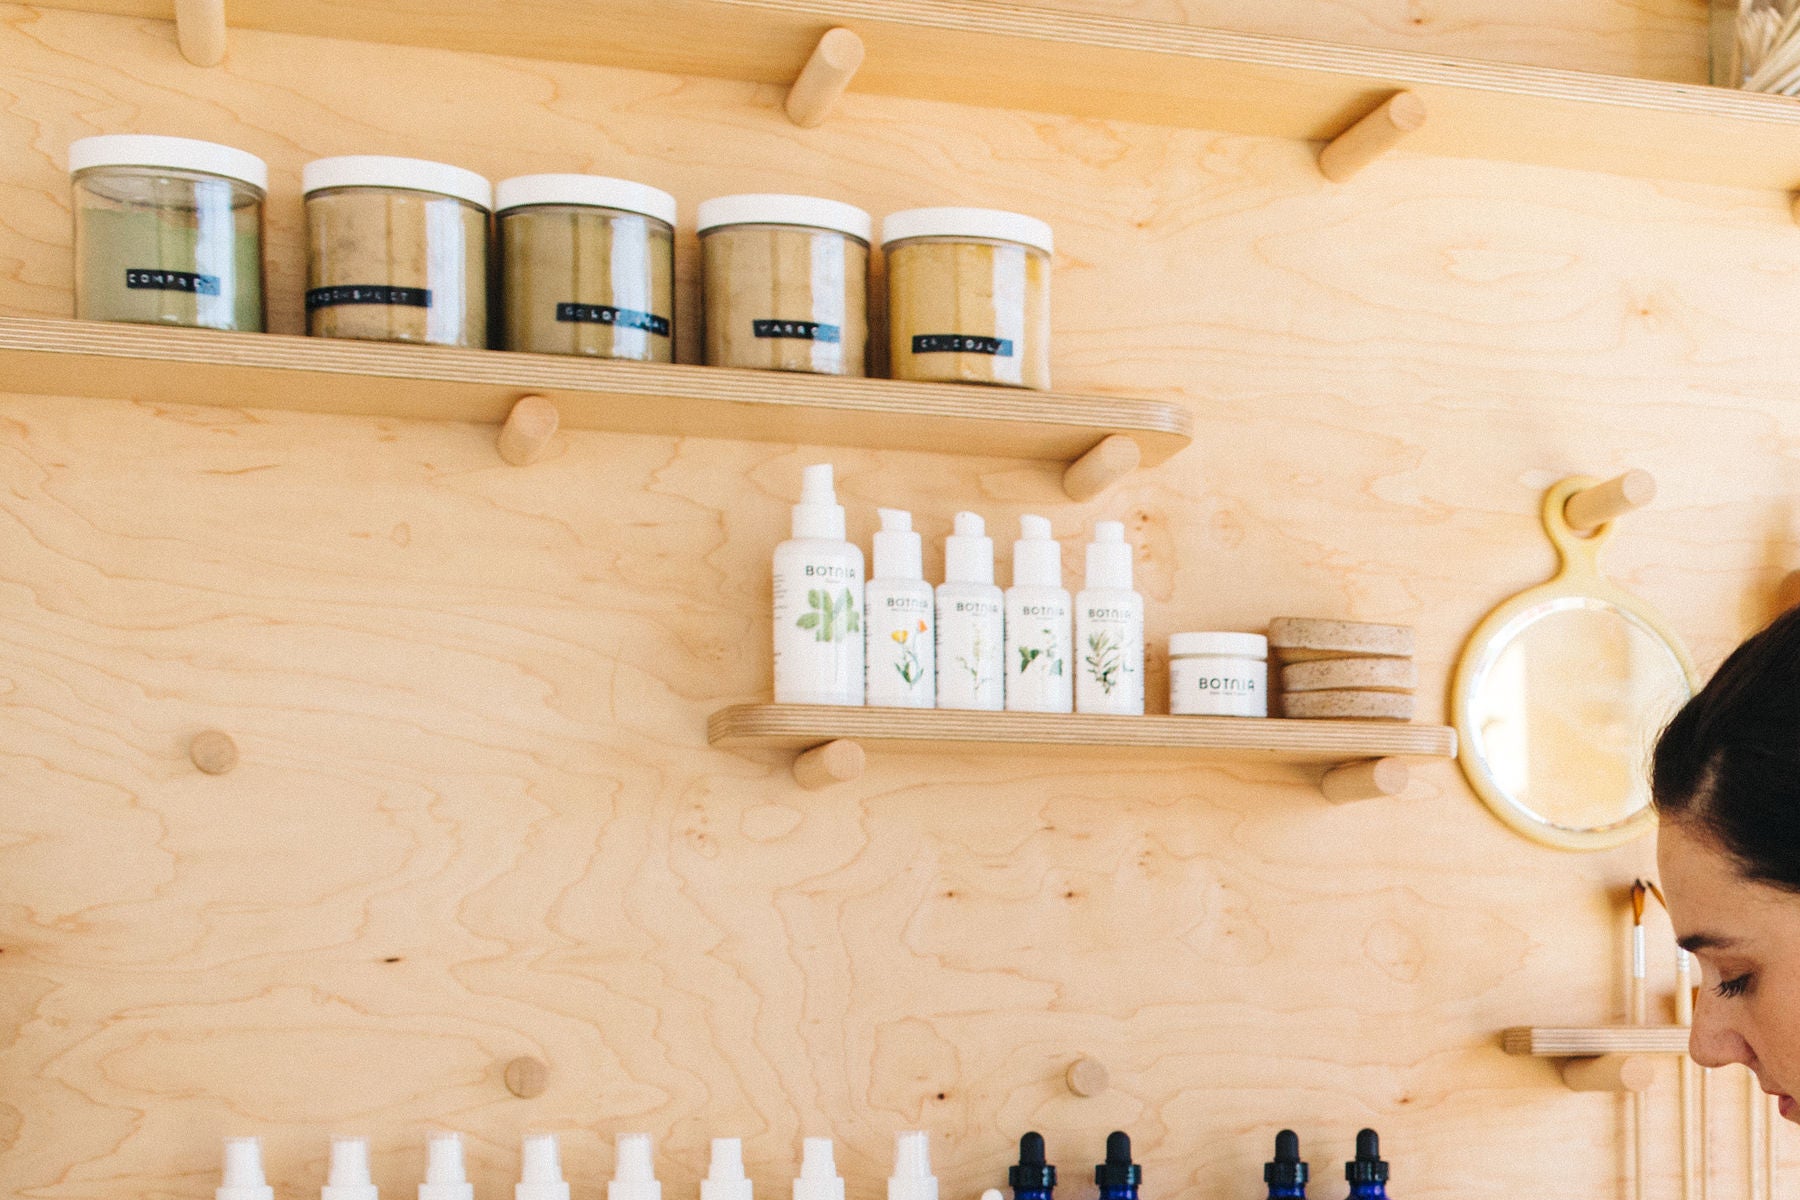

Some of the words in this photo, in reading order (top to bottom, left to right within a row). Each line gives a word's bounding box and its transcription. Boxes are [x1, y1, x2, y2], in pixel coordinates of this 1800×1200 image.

[759, 324, 838, 340] YARRO
[804, 564, 856, 579] BOTNIA
[1198, 677, 1255, 691] BOTNIA
